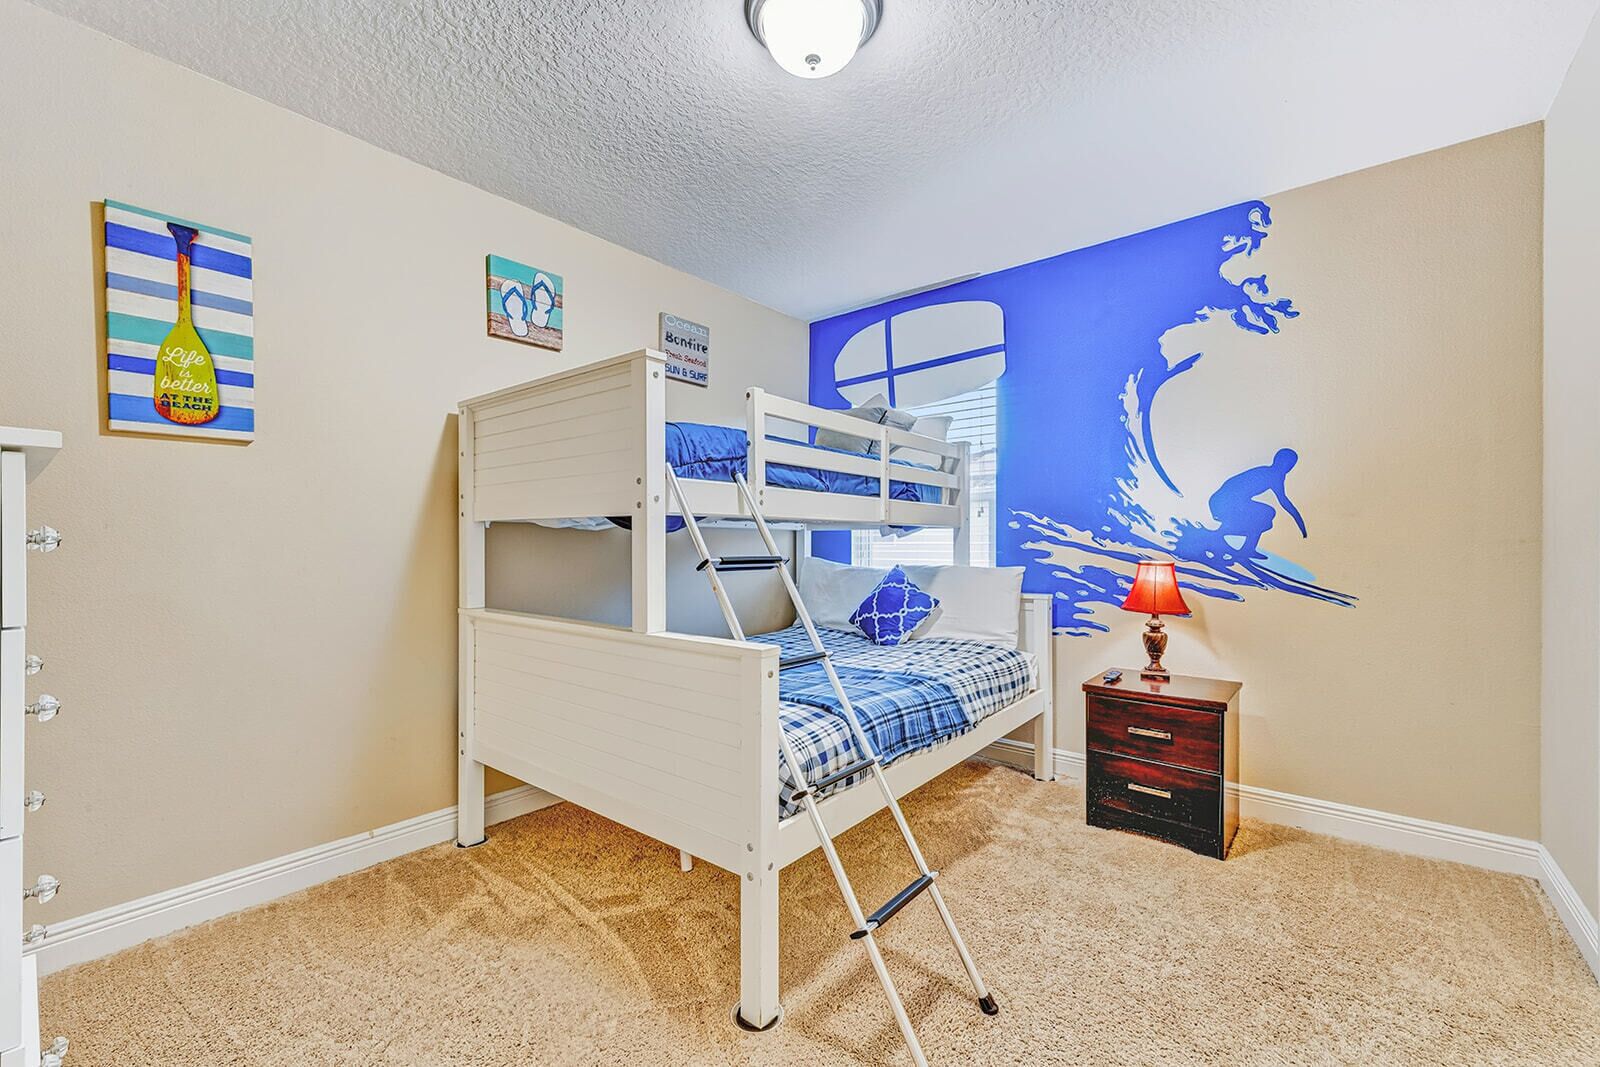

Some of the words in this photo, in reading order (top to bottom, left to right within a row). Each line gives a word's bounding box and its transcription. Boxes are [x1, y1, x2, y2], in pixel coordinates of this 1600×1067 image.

[665, 331, 708, 354] Bonfire
[162, 347, 206, 368] Life
[179, 368, 192, 378] is
[665, 363, 680, 375] SUN
[689, 370, 707, 382] SURF
[160, 376, 211, 394] better
[161, 400, 212, 411] BEACH
[183, 395, 213, 404] THE
